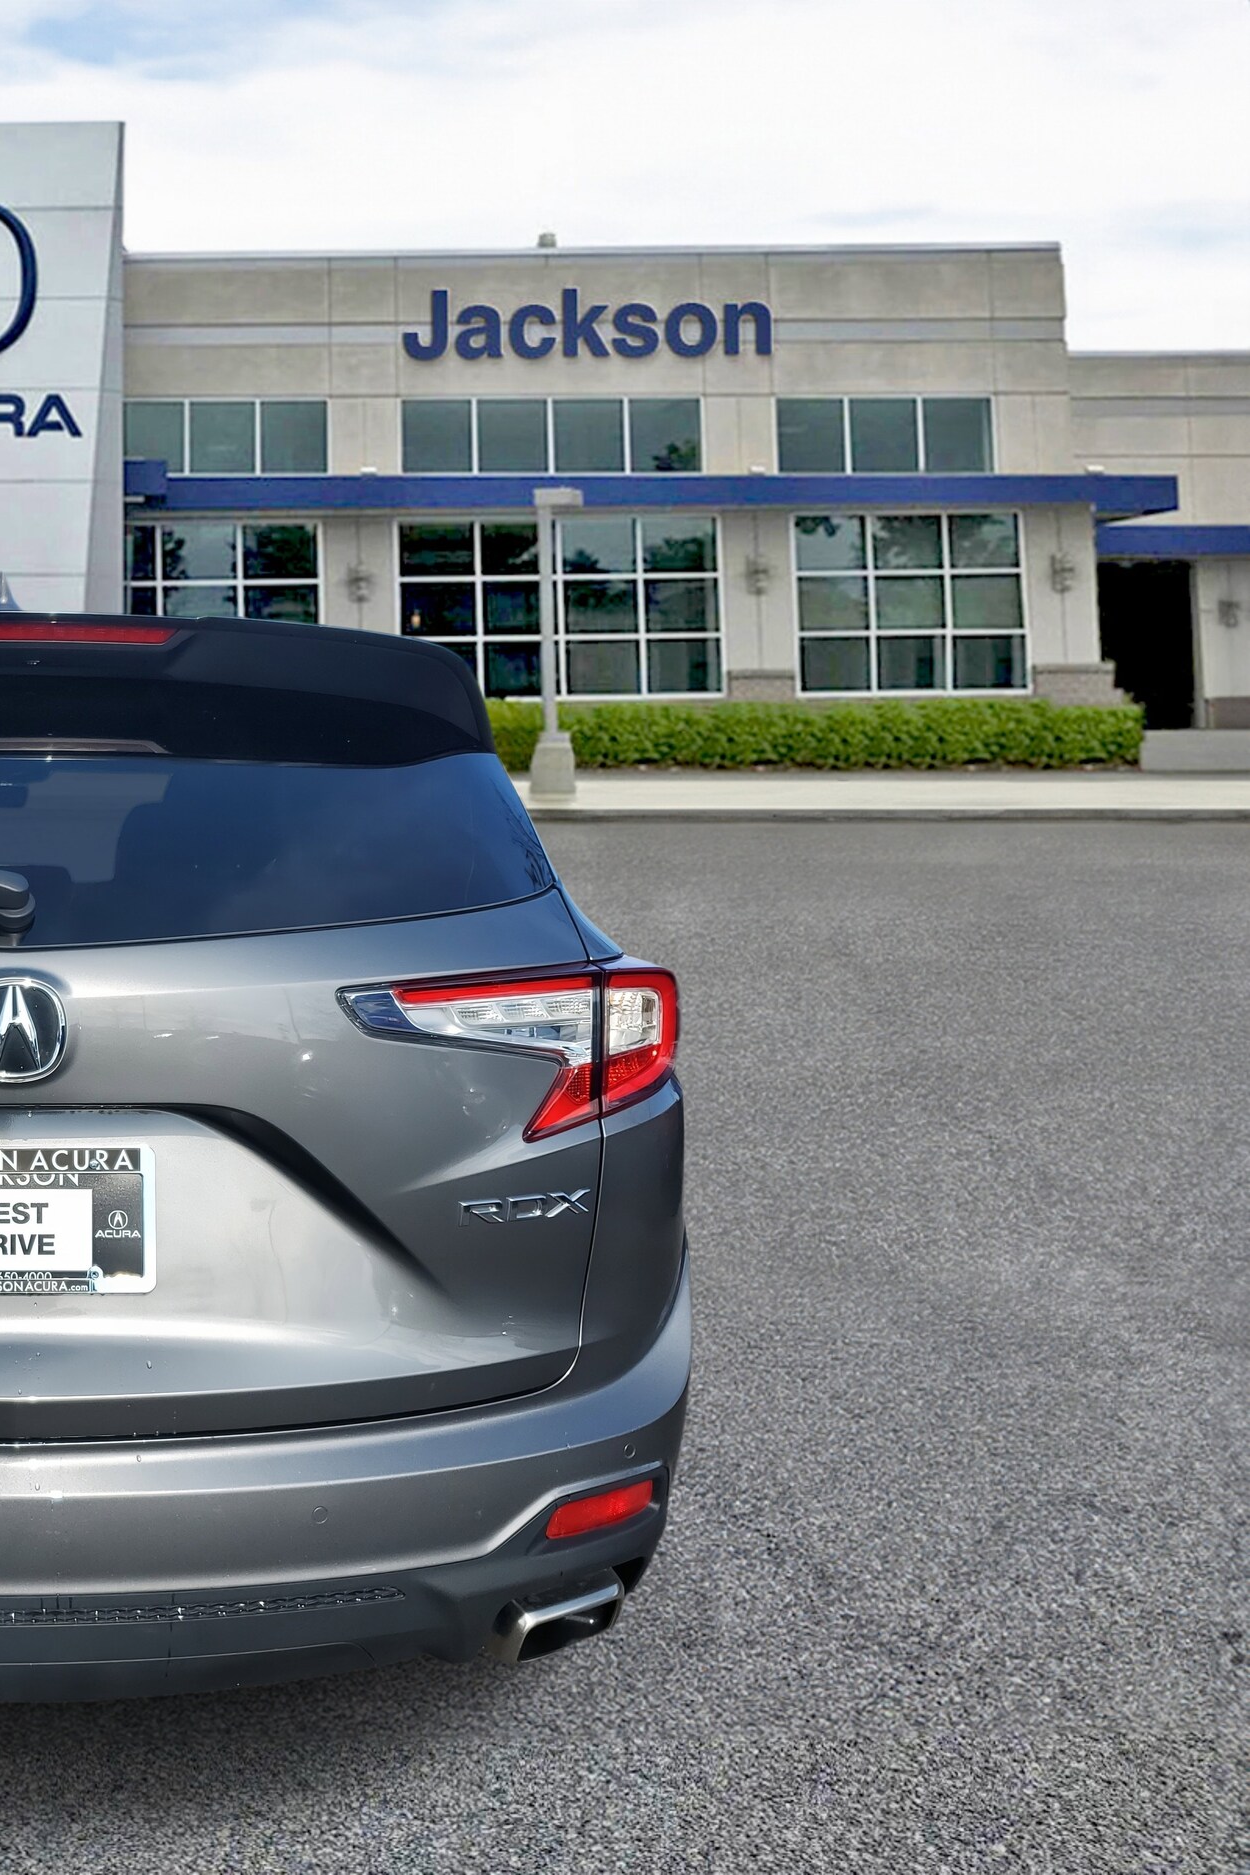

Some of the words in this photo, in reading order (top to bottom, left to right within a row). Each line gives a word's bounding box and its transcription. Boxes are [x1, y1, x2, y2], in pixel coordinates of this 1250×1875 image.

[402, 288, 773, 361] Jackson
[29, 1149, 134, 1171] ACURA
[457, 1188, 591, 1227] RDX
[94, 1229, 142, 1239] ACURA
